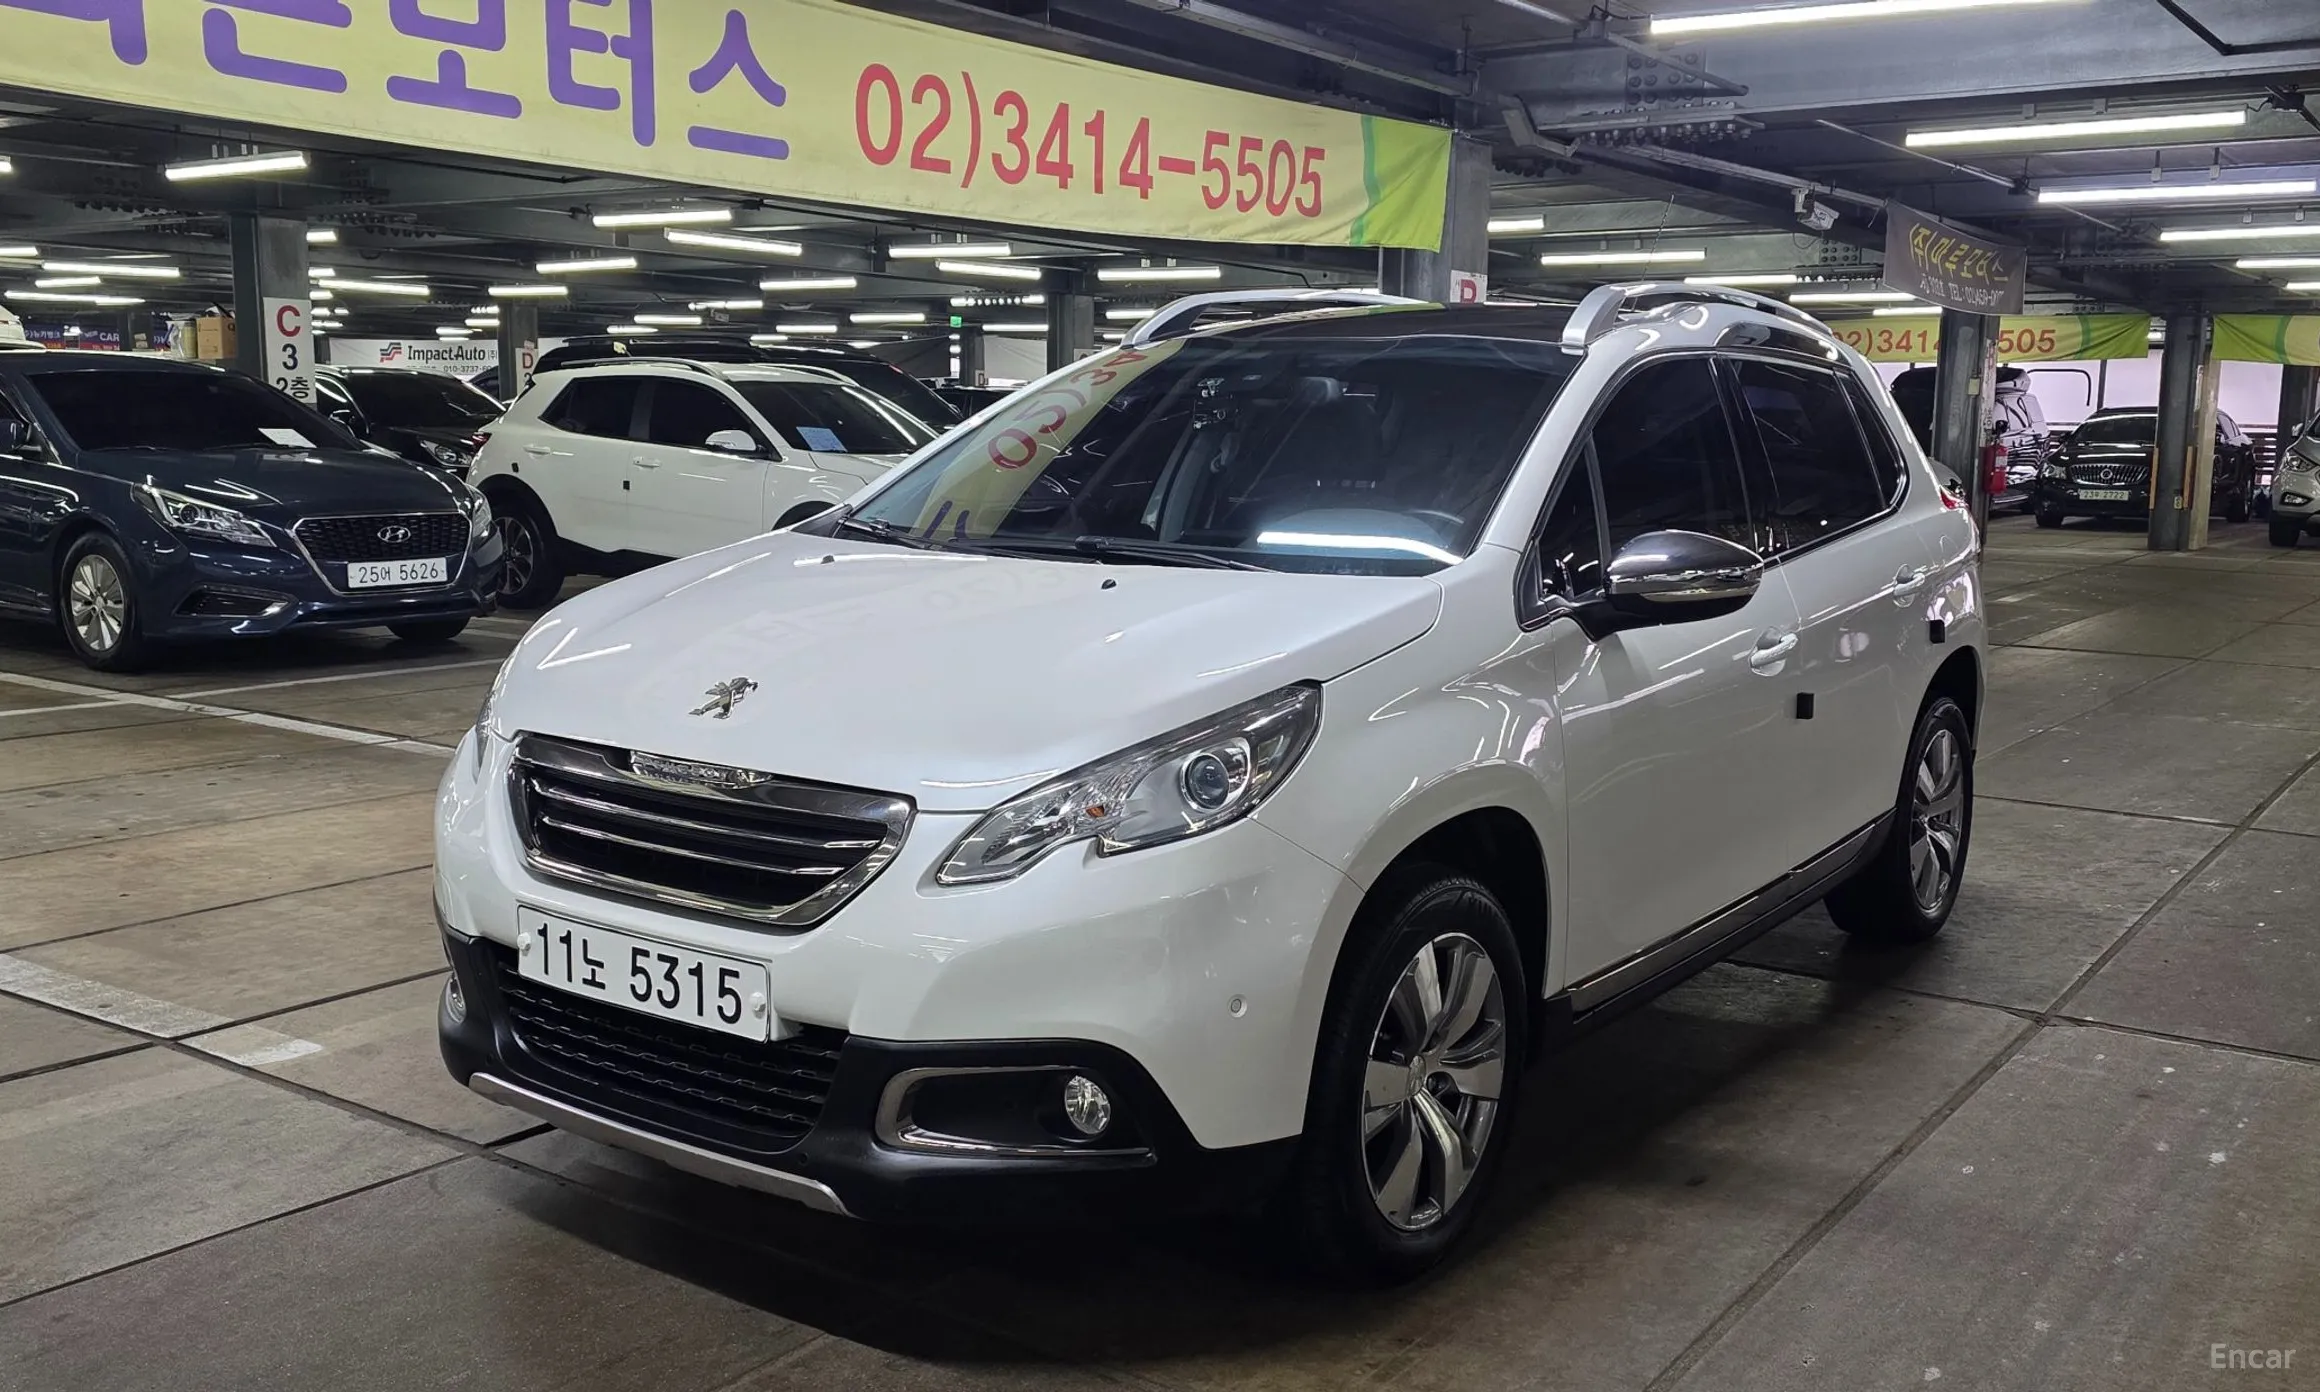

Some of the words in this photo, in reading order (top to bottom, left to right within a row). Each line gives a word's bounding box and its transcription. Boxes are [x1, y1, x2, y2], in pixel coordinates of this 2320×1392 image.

[0, 0, 789, 160] 모터스
[855, 63, 1326, 218] 02)3414-5505
[276, 304, 301, 337] C
[99, 332, 120, 341] CAR
[282, 343, 299, 370] 3
[522, 352, 534, 369] D
[359, 565, 391, 583] 25어
[400, 562, 438, 580] 5626
[537, 922, 606, 990] 11노
[630, 946, 742, 1025] 5315
